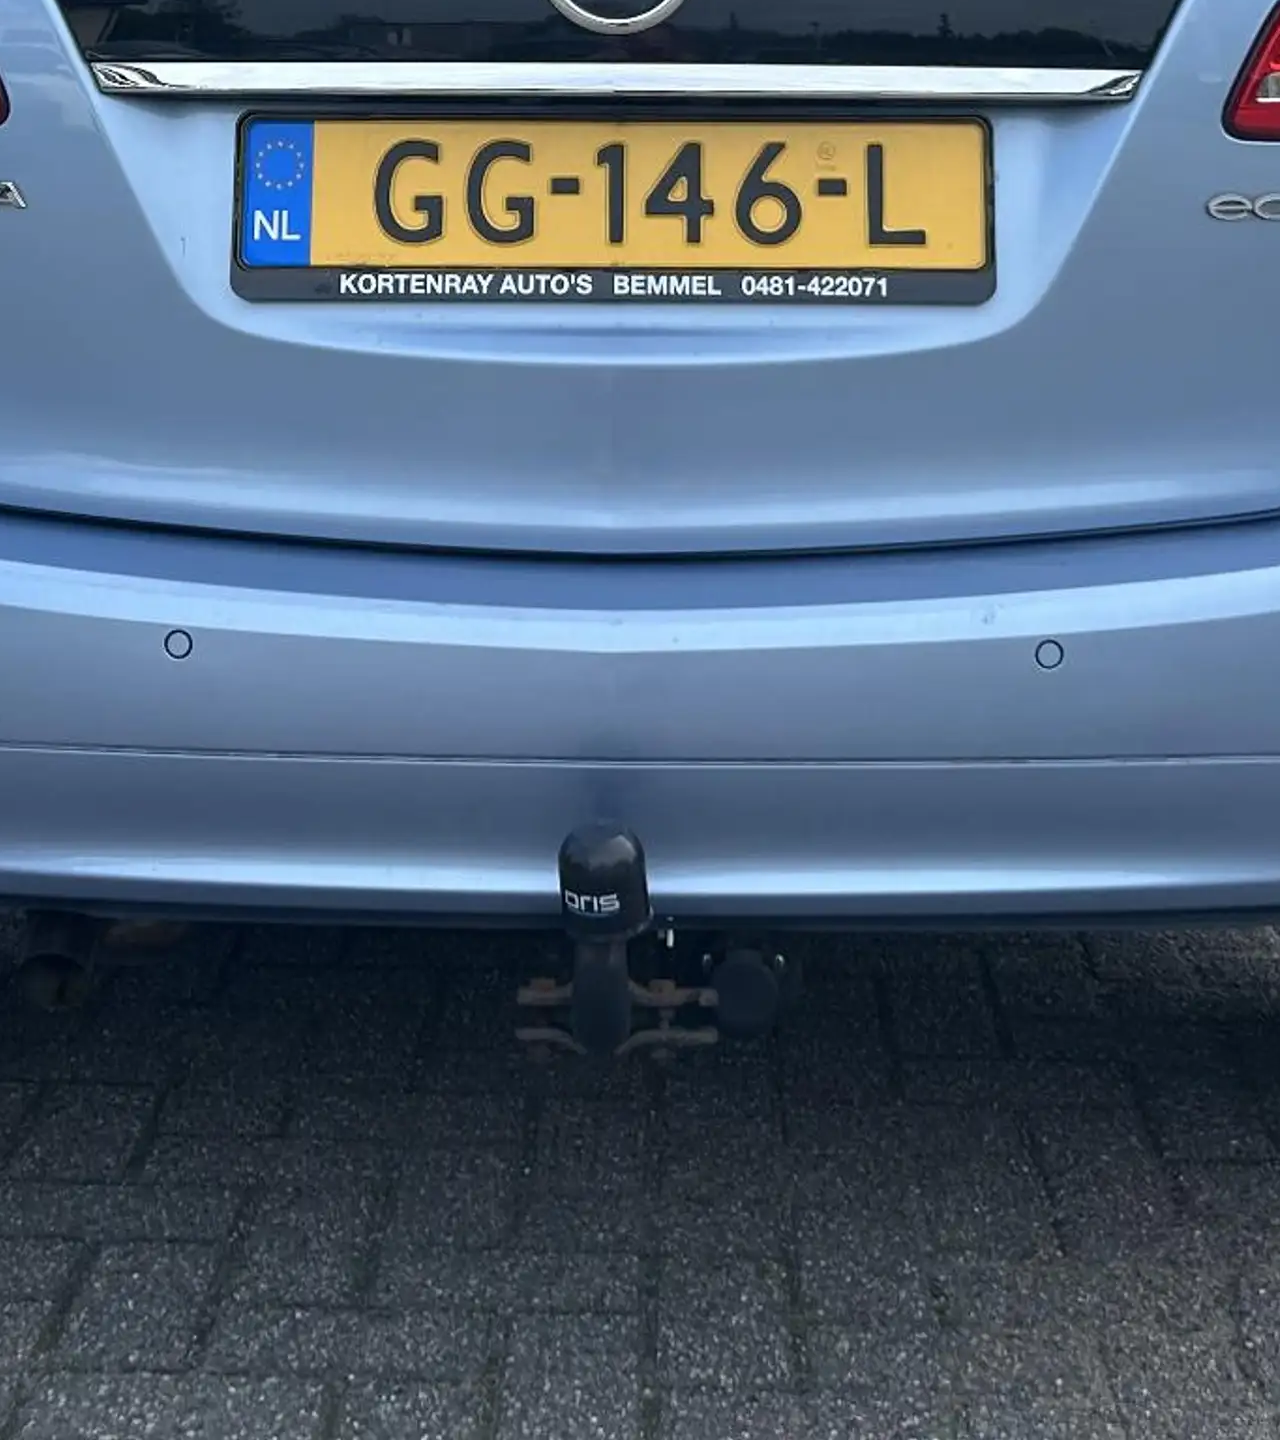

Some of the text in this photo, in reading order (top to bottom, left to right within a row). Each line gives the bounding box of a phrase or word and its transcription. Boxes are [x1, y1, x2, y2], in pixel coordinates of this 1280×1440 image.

[375, 141, 927, 246] GG-146-L
[253, 211, 301, 242] NL
[340, 274, 890, 298] KORTENRAY AUTO'S BEMMEL 0481-422071
